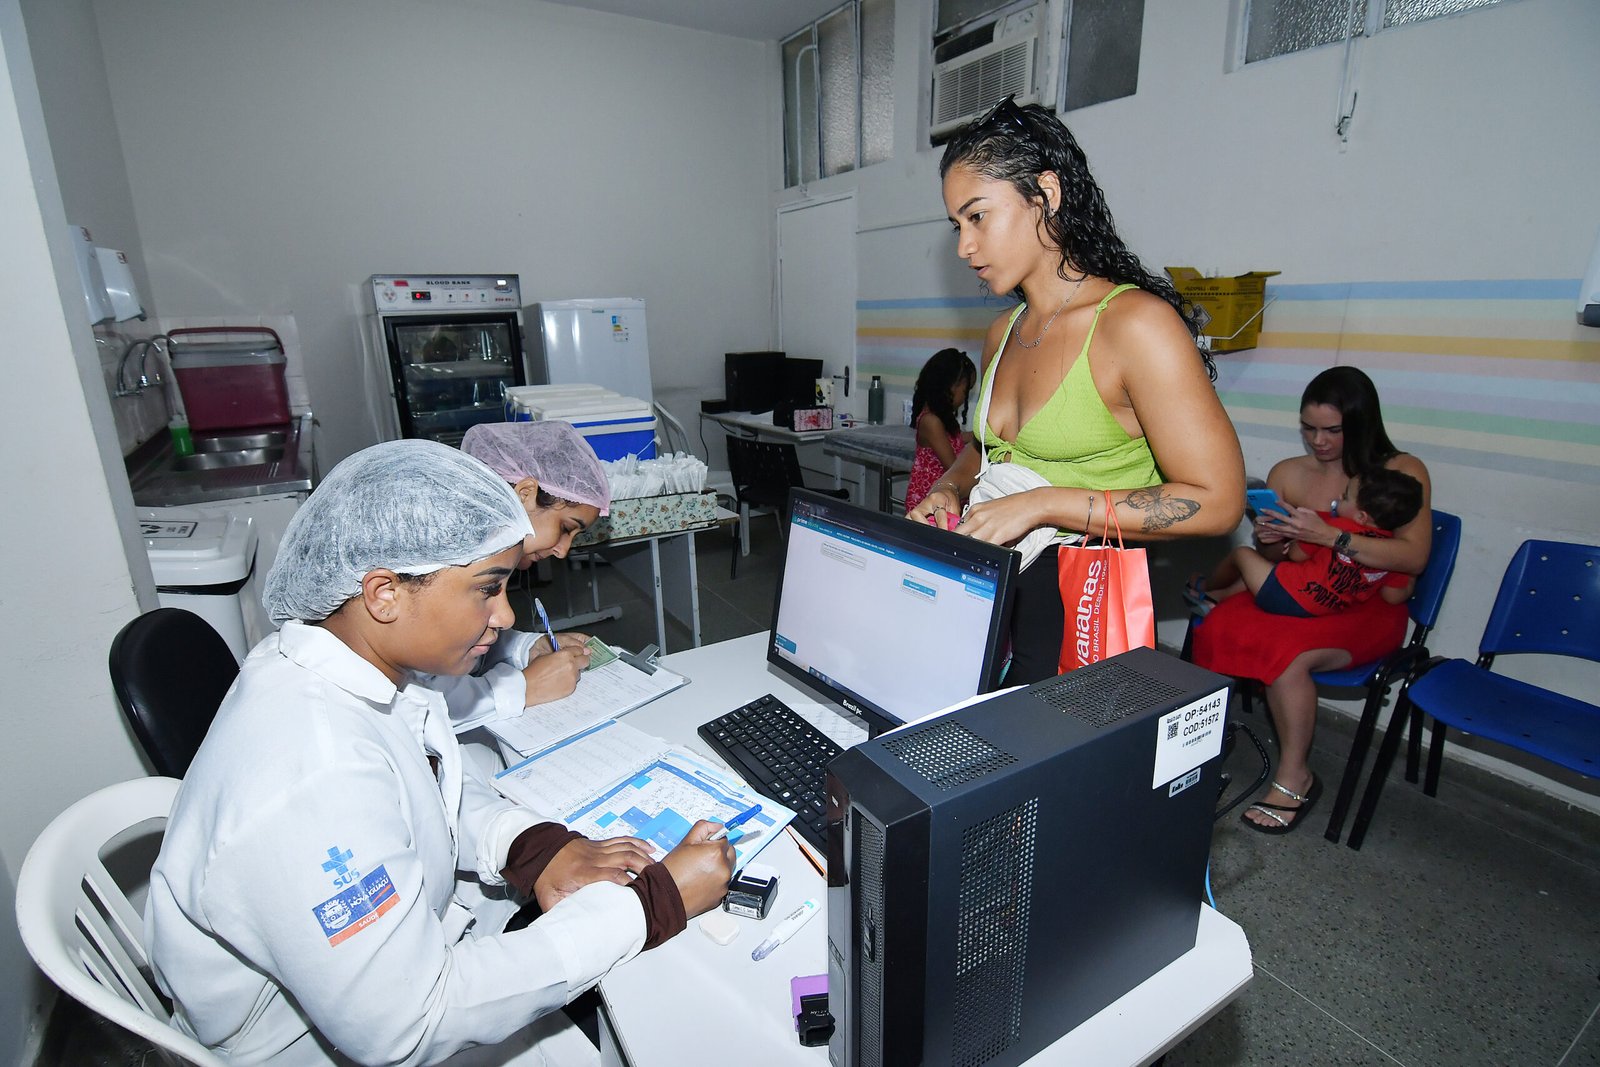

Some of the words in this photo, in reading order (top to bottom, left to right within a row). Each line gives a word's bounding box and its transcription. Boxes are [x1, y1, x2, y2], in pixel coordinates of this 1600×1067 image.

[1094, 583, 1105, 614] DESDE
[1184, 698, 1221, 722] OP:54143
[1183, 712, 1219, 737] COD:51572
[333, 867, 360, 890] SUS
[350, 894, 370, 908] NOVA
[368, 877, 389, 897] IGUAÇU
